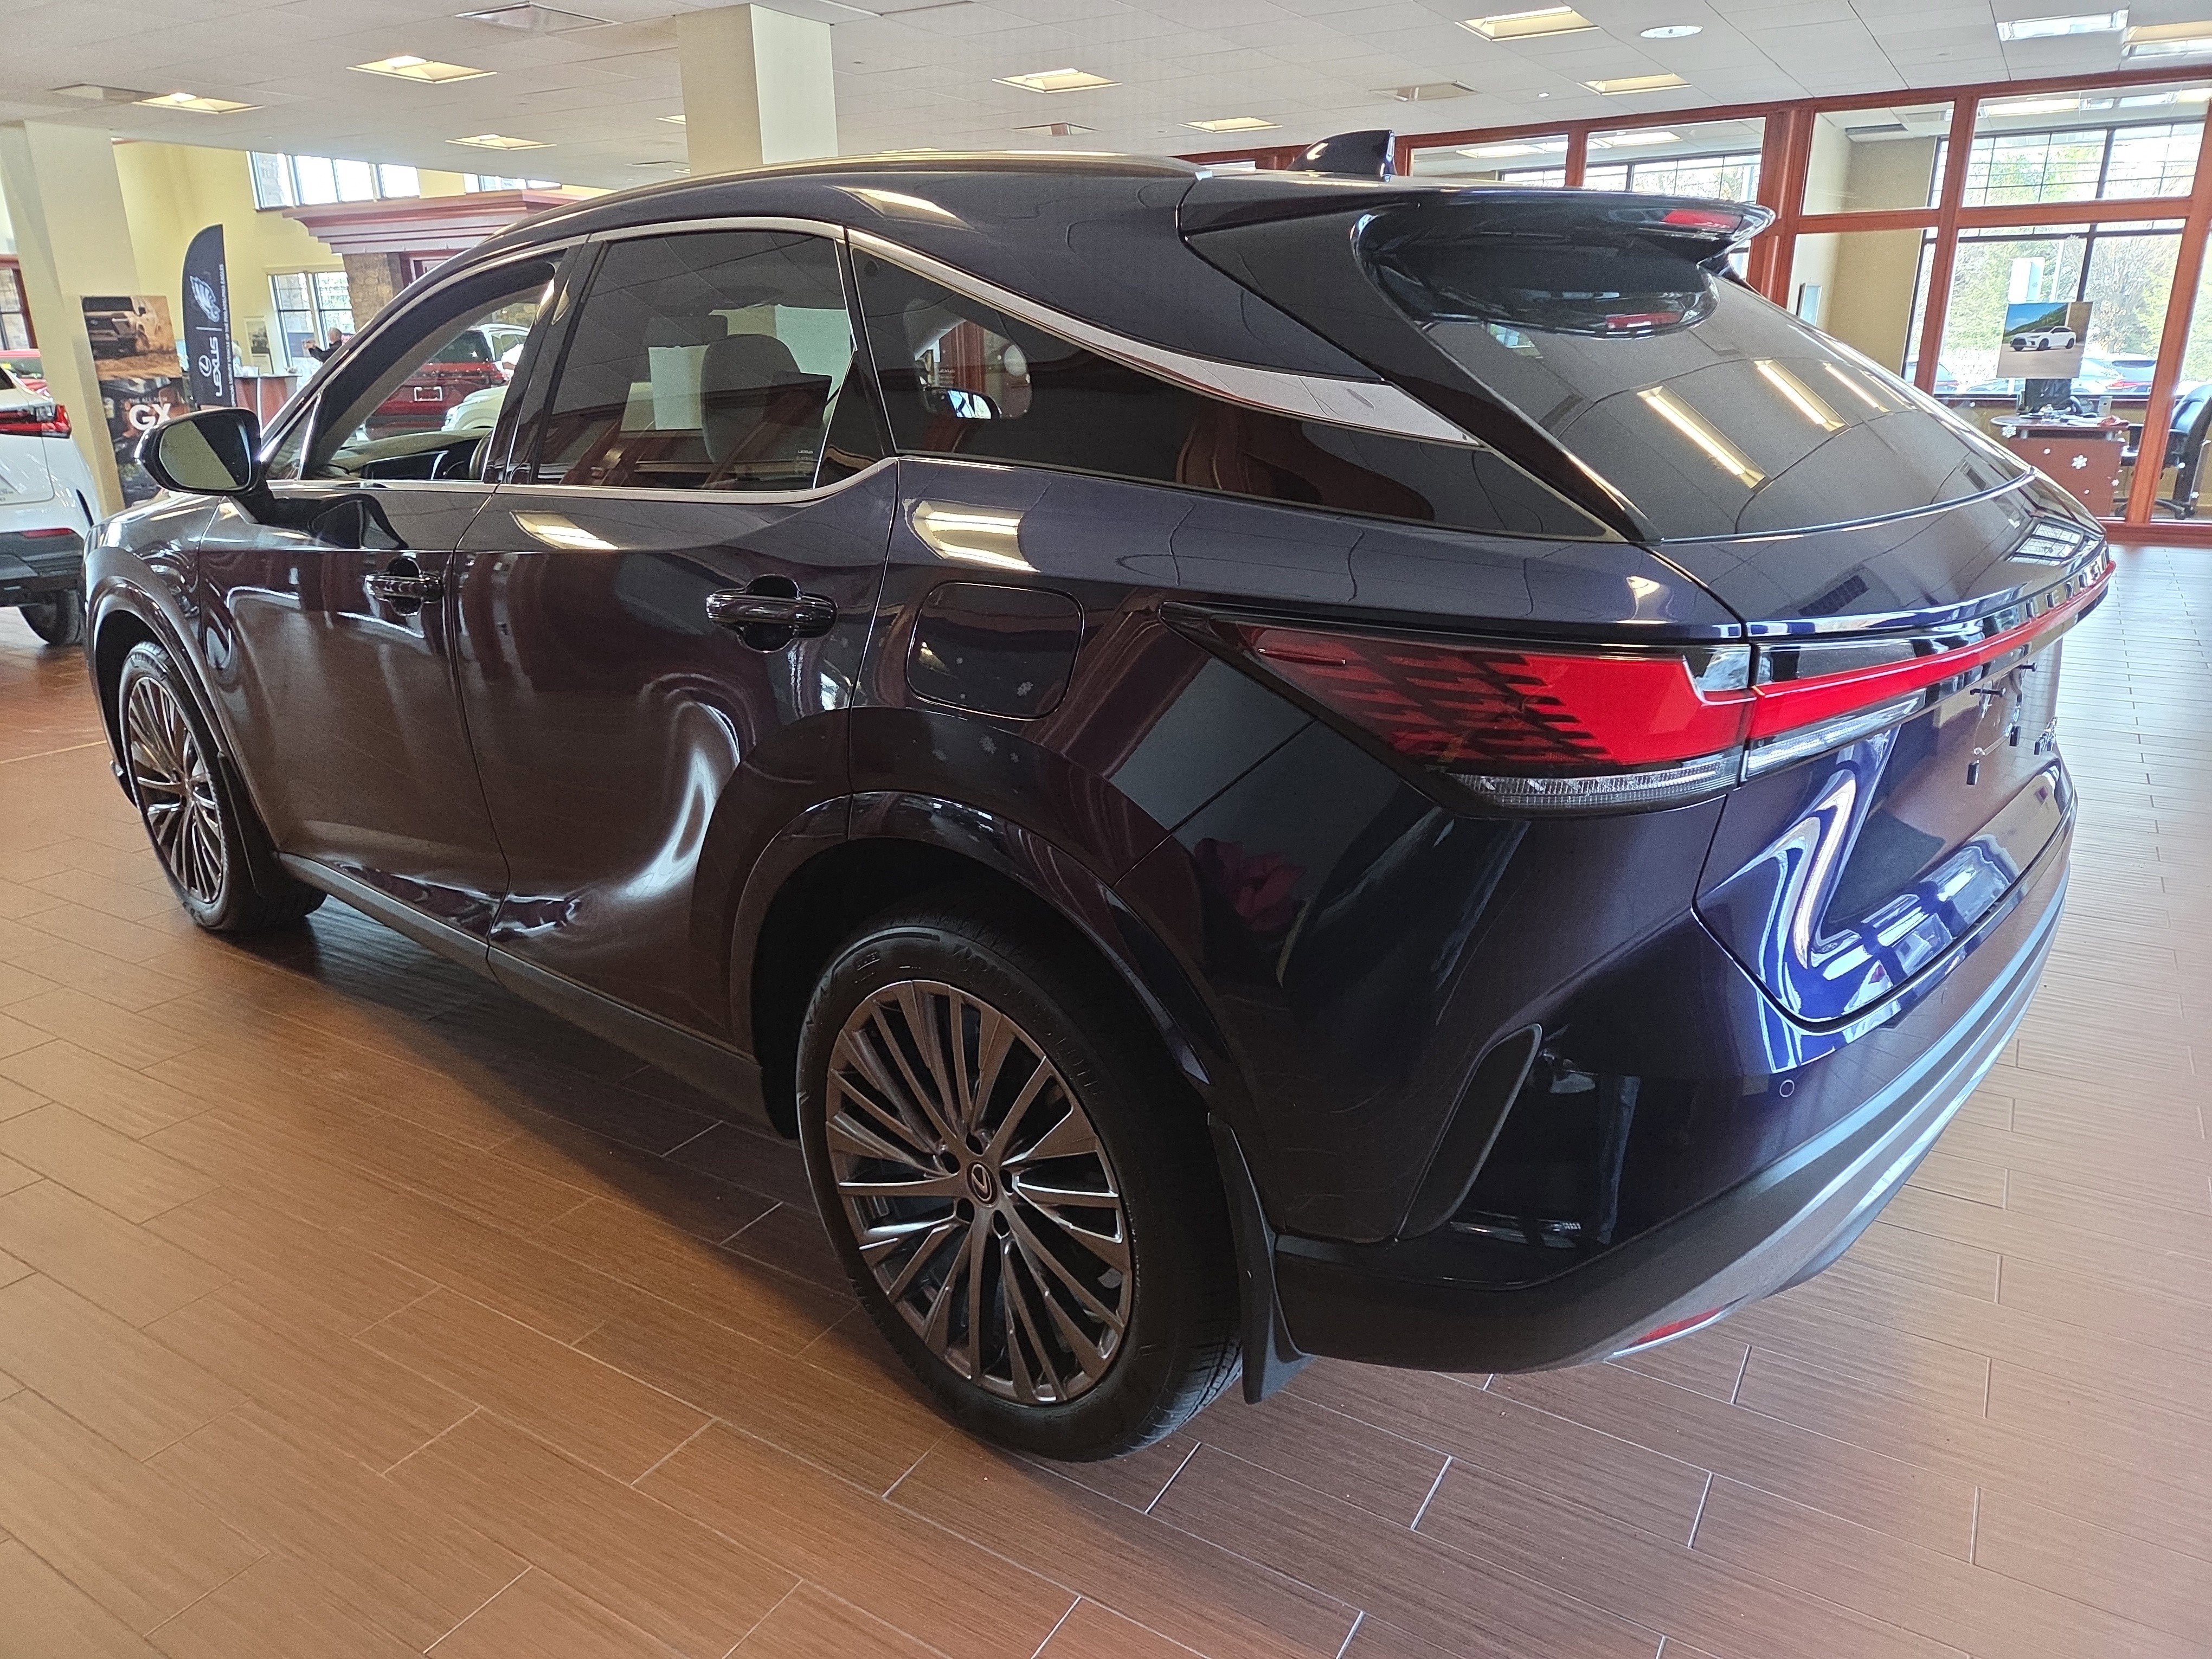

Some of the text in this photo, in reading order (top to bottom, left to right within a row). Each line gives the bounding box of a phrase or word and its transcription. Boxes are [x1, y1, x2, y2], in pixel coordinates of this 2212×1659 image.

[210, 337, 222, 397] LEXUS
[129, 403, 171, 431] GX
[2025, 560, 2101, 618] LEXUS
